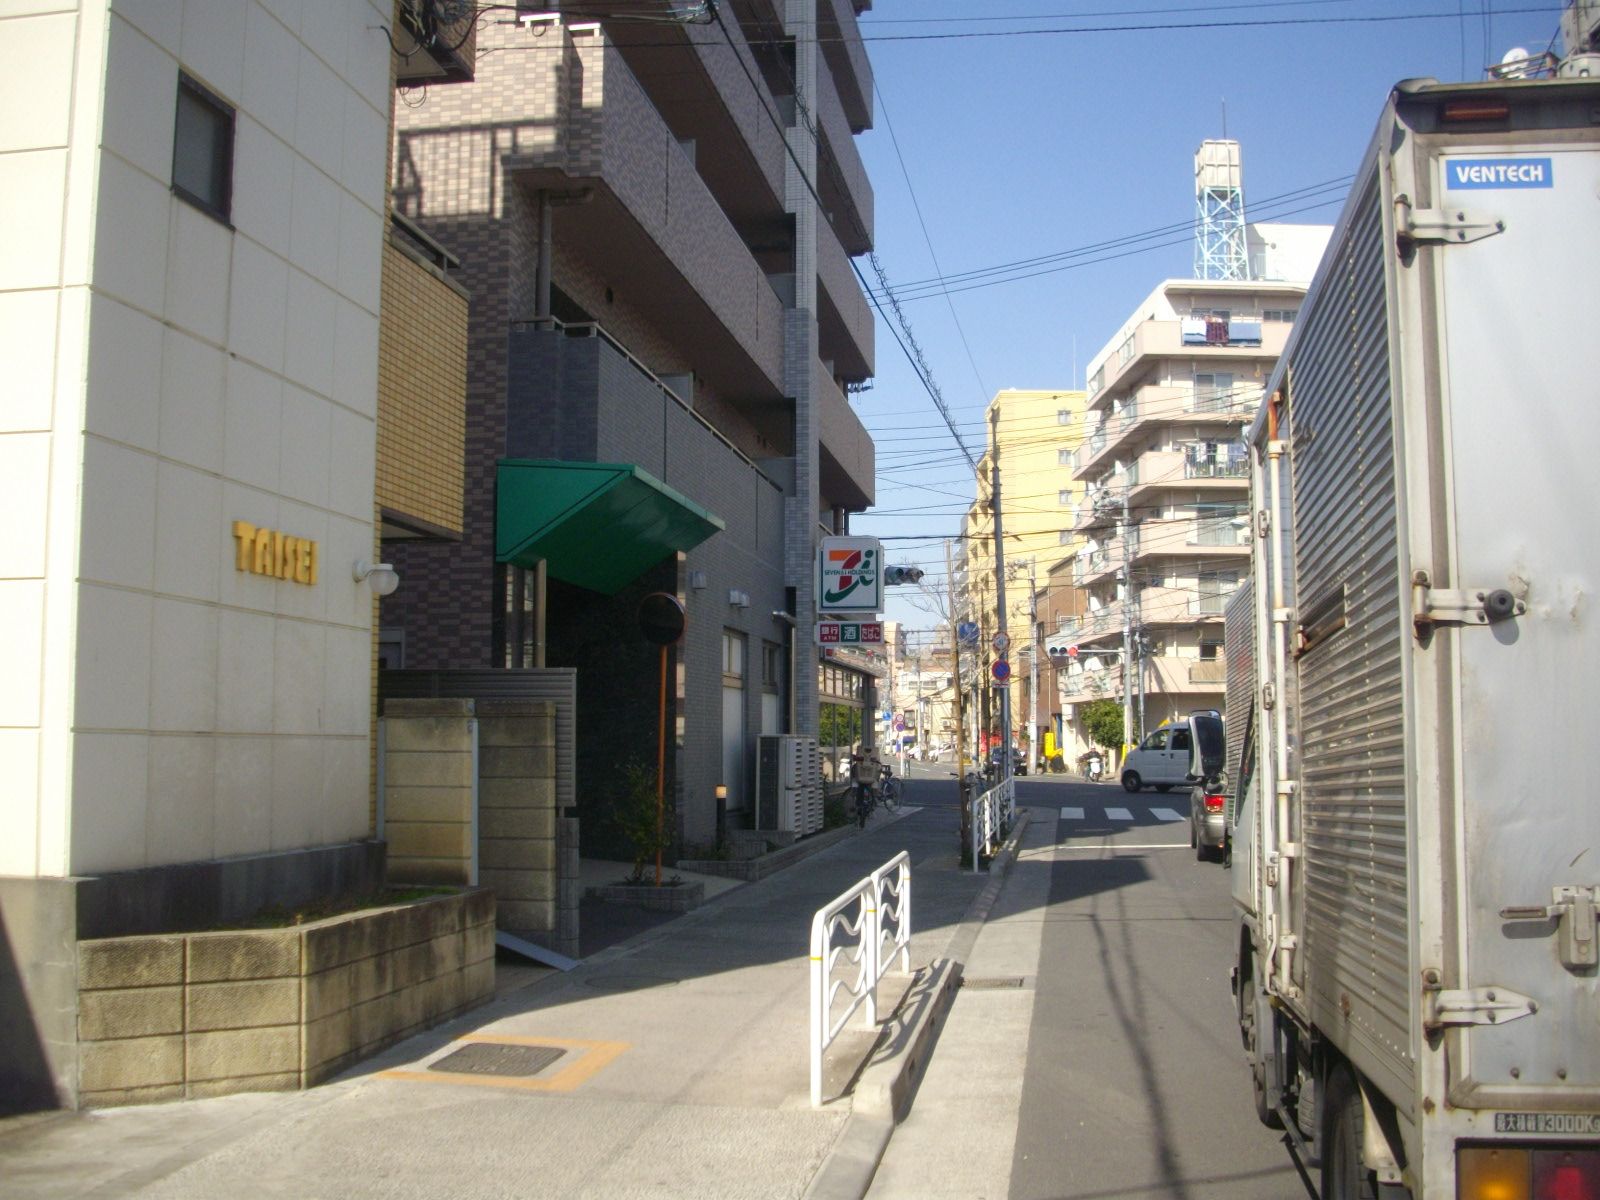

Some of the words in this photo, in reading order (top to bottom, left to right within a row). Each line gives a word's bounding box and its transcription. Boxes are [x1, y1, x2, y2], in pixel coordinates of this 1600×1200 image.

[1456, 165, 1543, 183] VENTECH
[233, 519, 319, 585] TAISEI
[844, 626, 857, 640] 酒
[861, 626, 880, 640] たばこ
